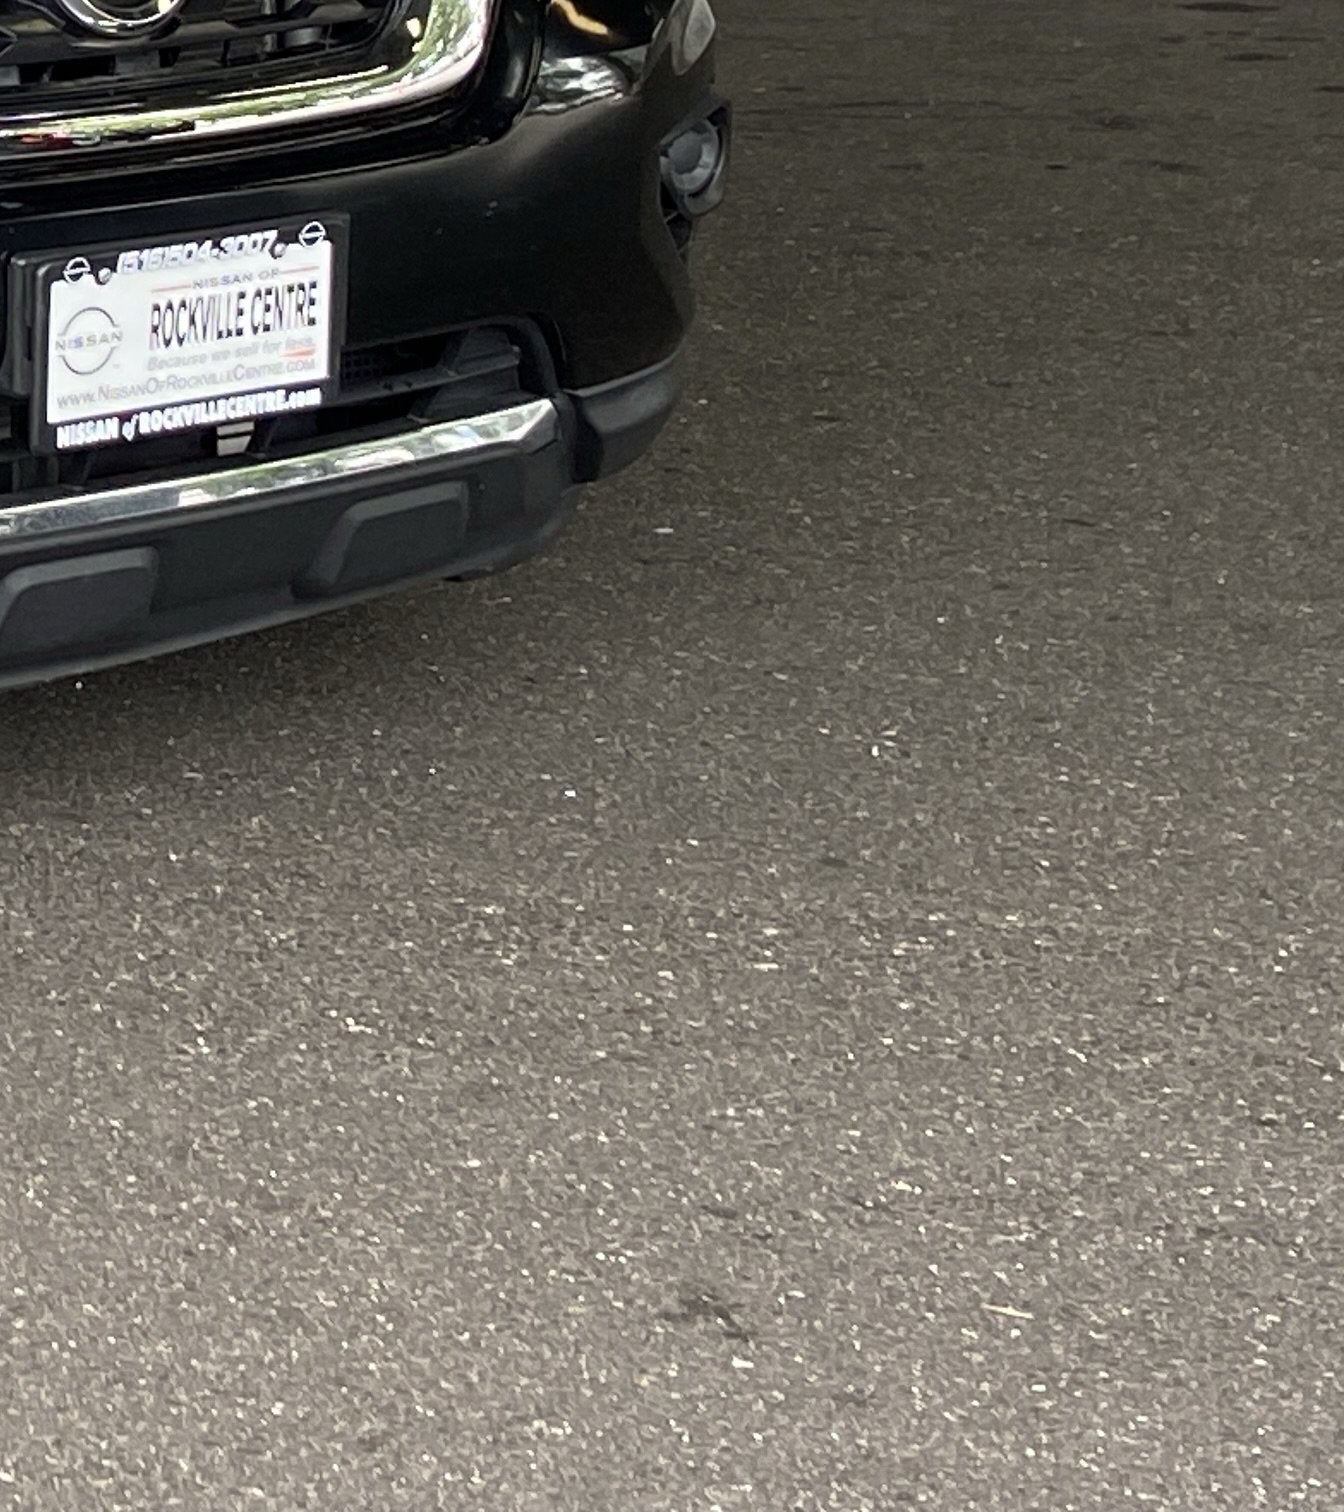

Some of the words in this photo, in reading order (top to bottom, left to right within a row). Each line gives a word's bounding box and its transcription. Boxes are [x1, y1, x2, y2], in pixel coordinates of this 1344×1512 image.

[192, 273, 253, 289] NISSAN
[149, 290, 247, 350] ROCKVILLE
[250, 280, 318, 336] CENTRE
[55, 330, 123, 351] NISSAN
[56, 417, 120, 448] NISSAN
[122, 413, 138, 441] of
[138, 388, 321, 434] ROCKVILLECENTRE.com
